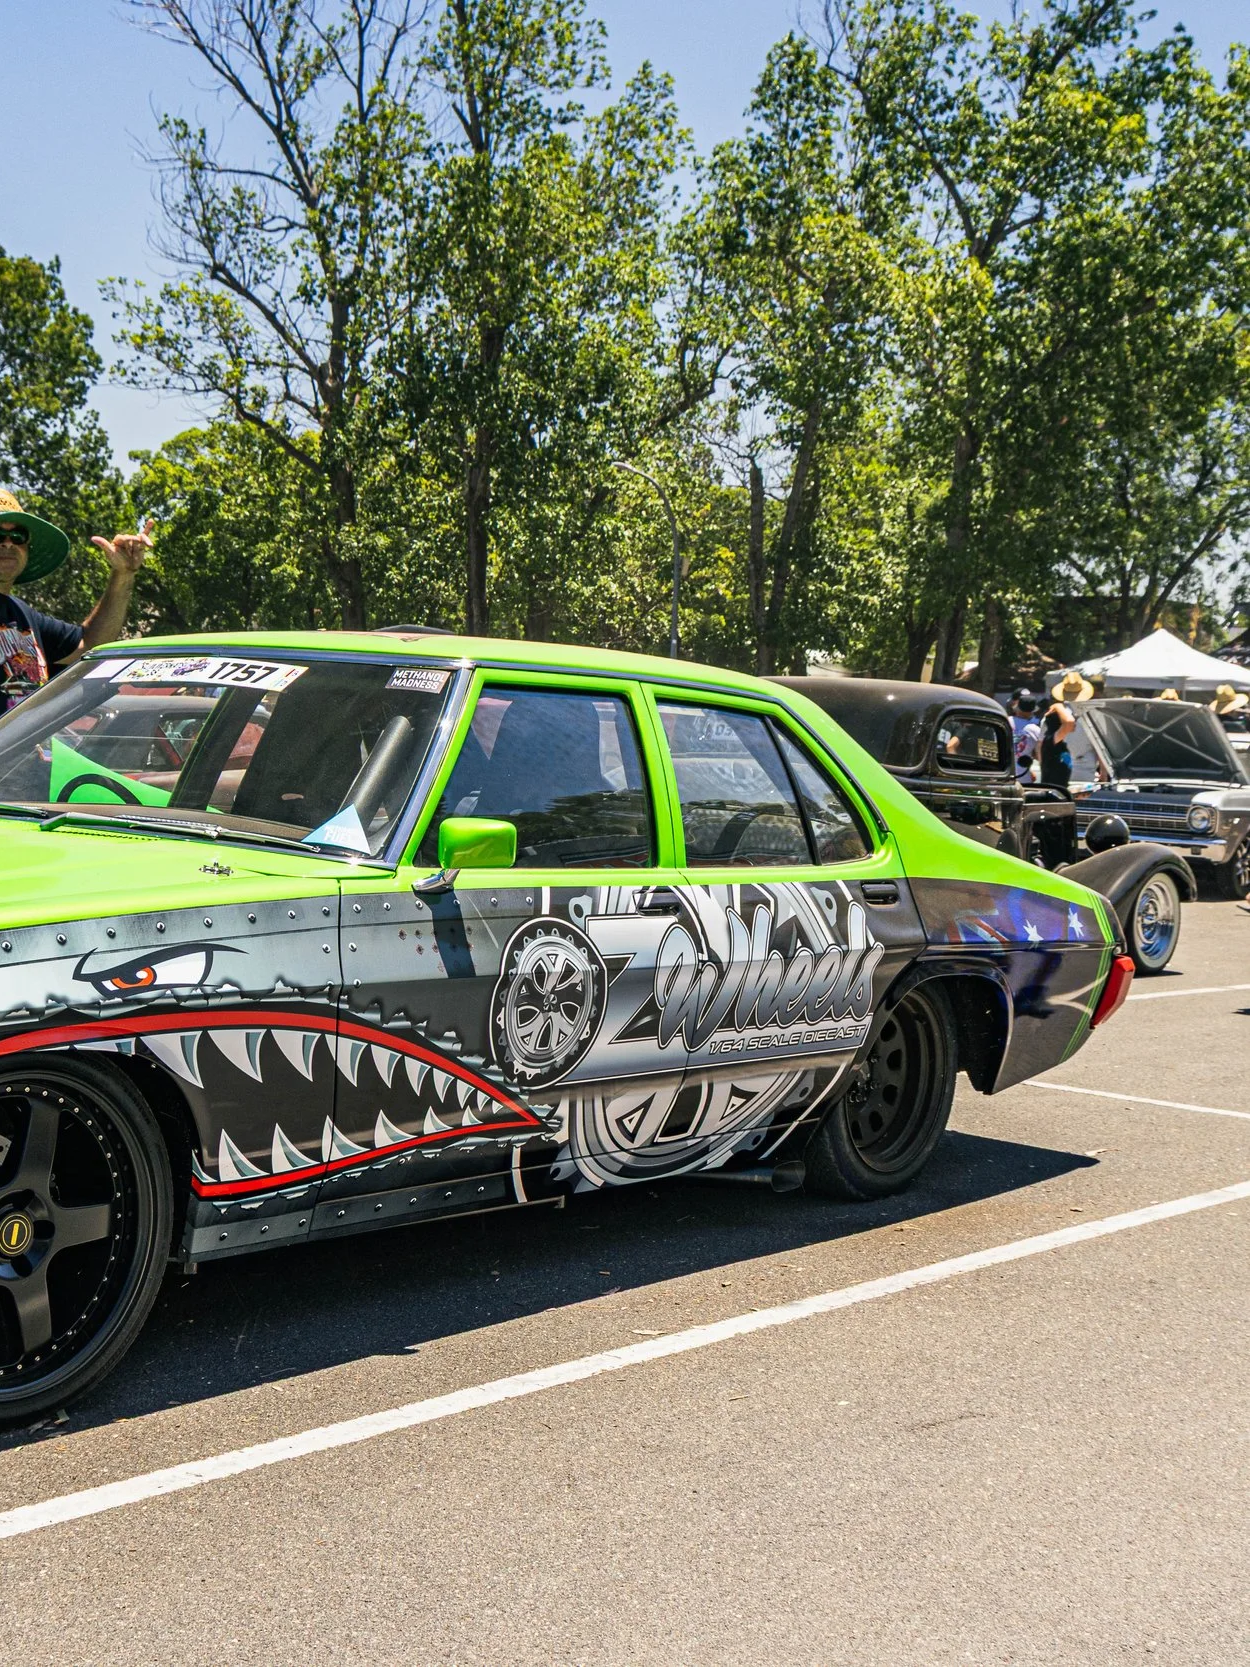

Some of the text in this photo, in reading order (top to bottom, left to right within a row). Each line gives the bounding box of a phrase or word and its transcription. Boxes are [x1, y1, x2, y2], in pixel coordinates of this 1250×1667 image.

[208, 661, 280, 684] 1757
[391, 678, 440, 690] MADNESS
[393, 670, 446, 682] METHANOL
[655, 899, 885, 1052] Wheels
[709, 1025, 867, 1055] 1/64 SCALE DIECAST
